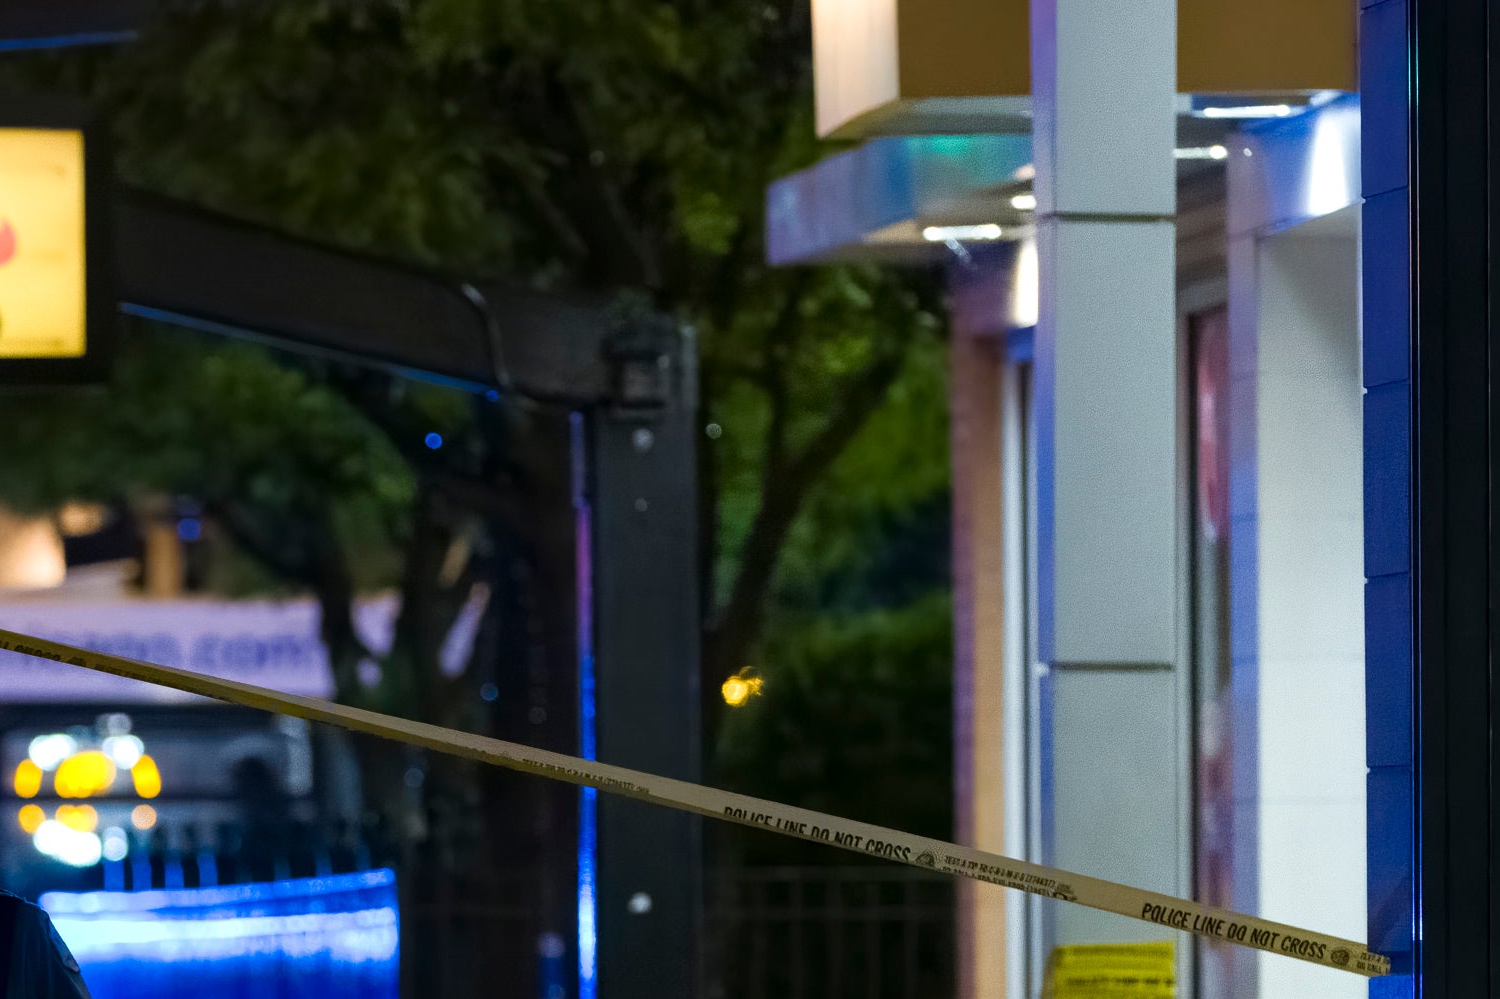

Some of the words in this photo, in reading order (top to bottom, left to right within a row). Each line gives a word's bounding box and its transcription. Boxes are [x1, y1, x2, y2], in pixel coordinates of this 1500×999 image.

[811, 826, 830, 841] DO
[834, 831, 863, 847] NOT
[865, 839, 912, 860] CROSS
[1141, 903, 1191, 928] POLICE
[1193, 914, 1226, 937] LINE
[1227, 922, 1247, 941] DO
[1250, 928, 1281, 947] NOT
[1280, 935, 1327, 960] CROSS
